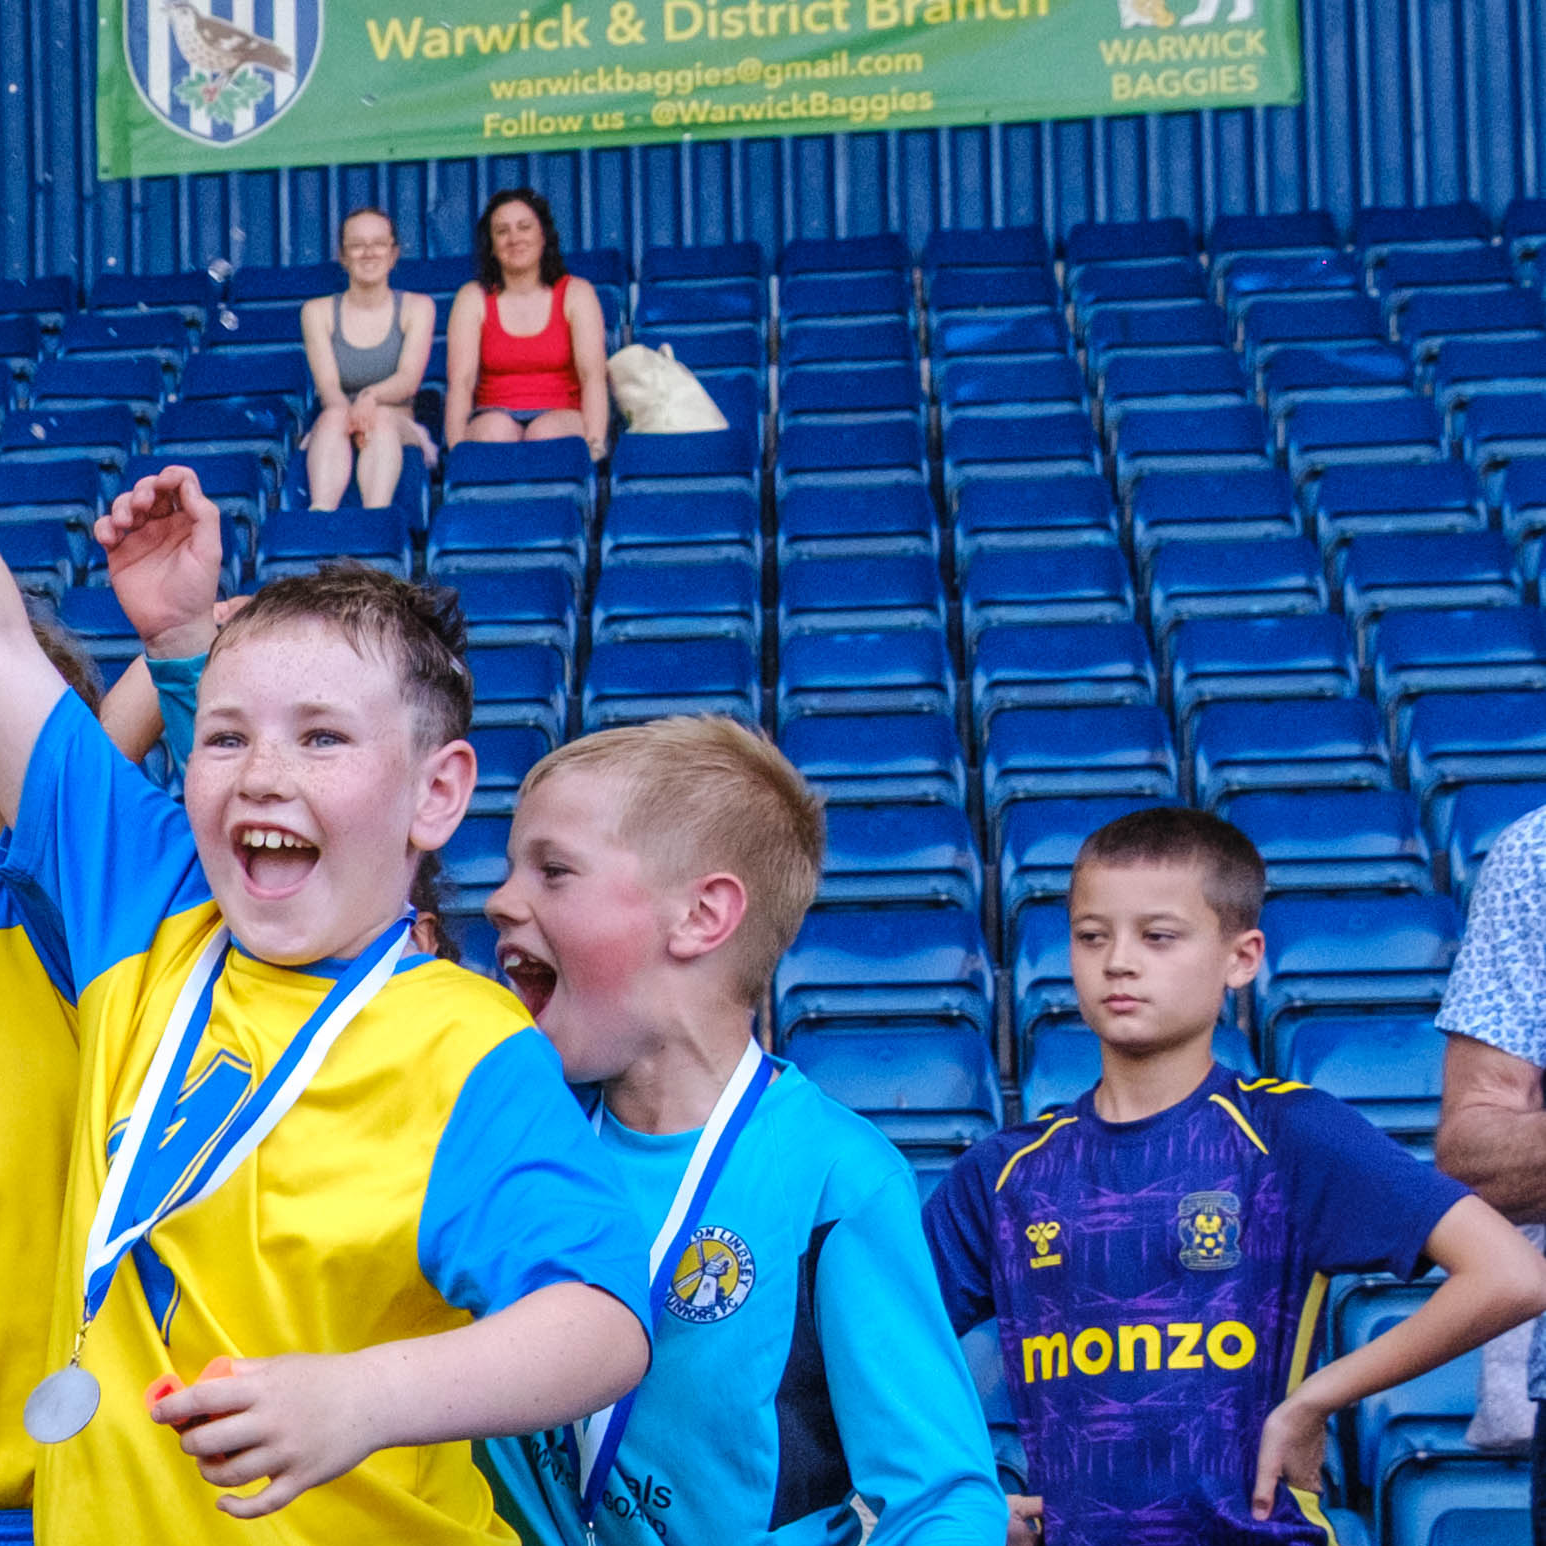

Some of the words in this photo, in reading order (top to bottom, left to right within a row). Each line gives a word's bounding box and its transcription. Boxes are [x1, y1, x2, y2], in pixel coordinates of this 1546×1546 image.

[366, 4, 591, 60] Warwick
[605, 1, 646, 46] &
[663, 0, 851, 42] District
[1098, 29, 1267, 65] WARWICK
[489, 50, 924, 99] warwickbaggies@gmail.com
[1111, 64, 1259, 101] BAGGIES
[483, 109, 584, 138] Follow
[592, 109, 625, 130] us
[650, 85, 934, 126] @WarwickBaggies
[665, 1291, 718, 1320] UNIORS
[1022, 1320, 1257, 1384] monzo
